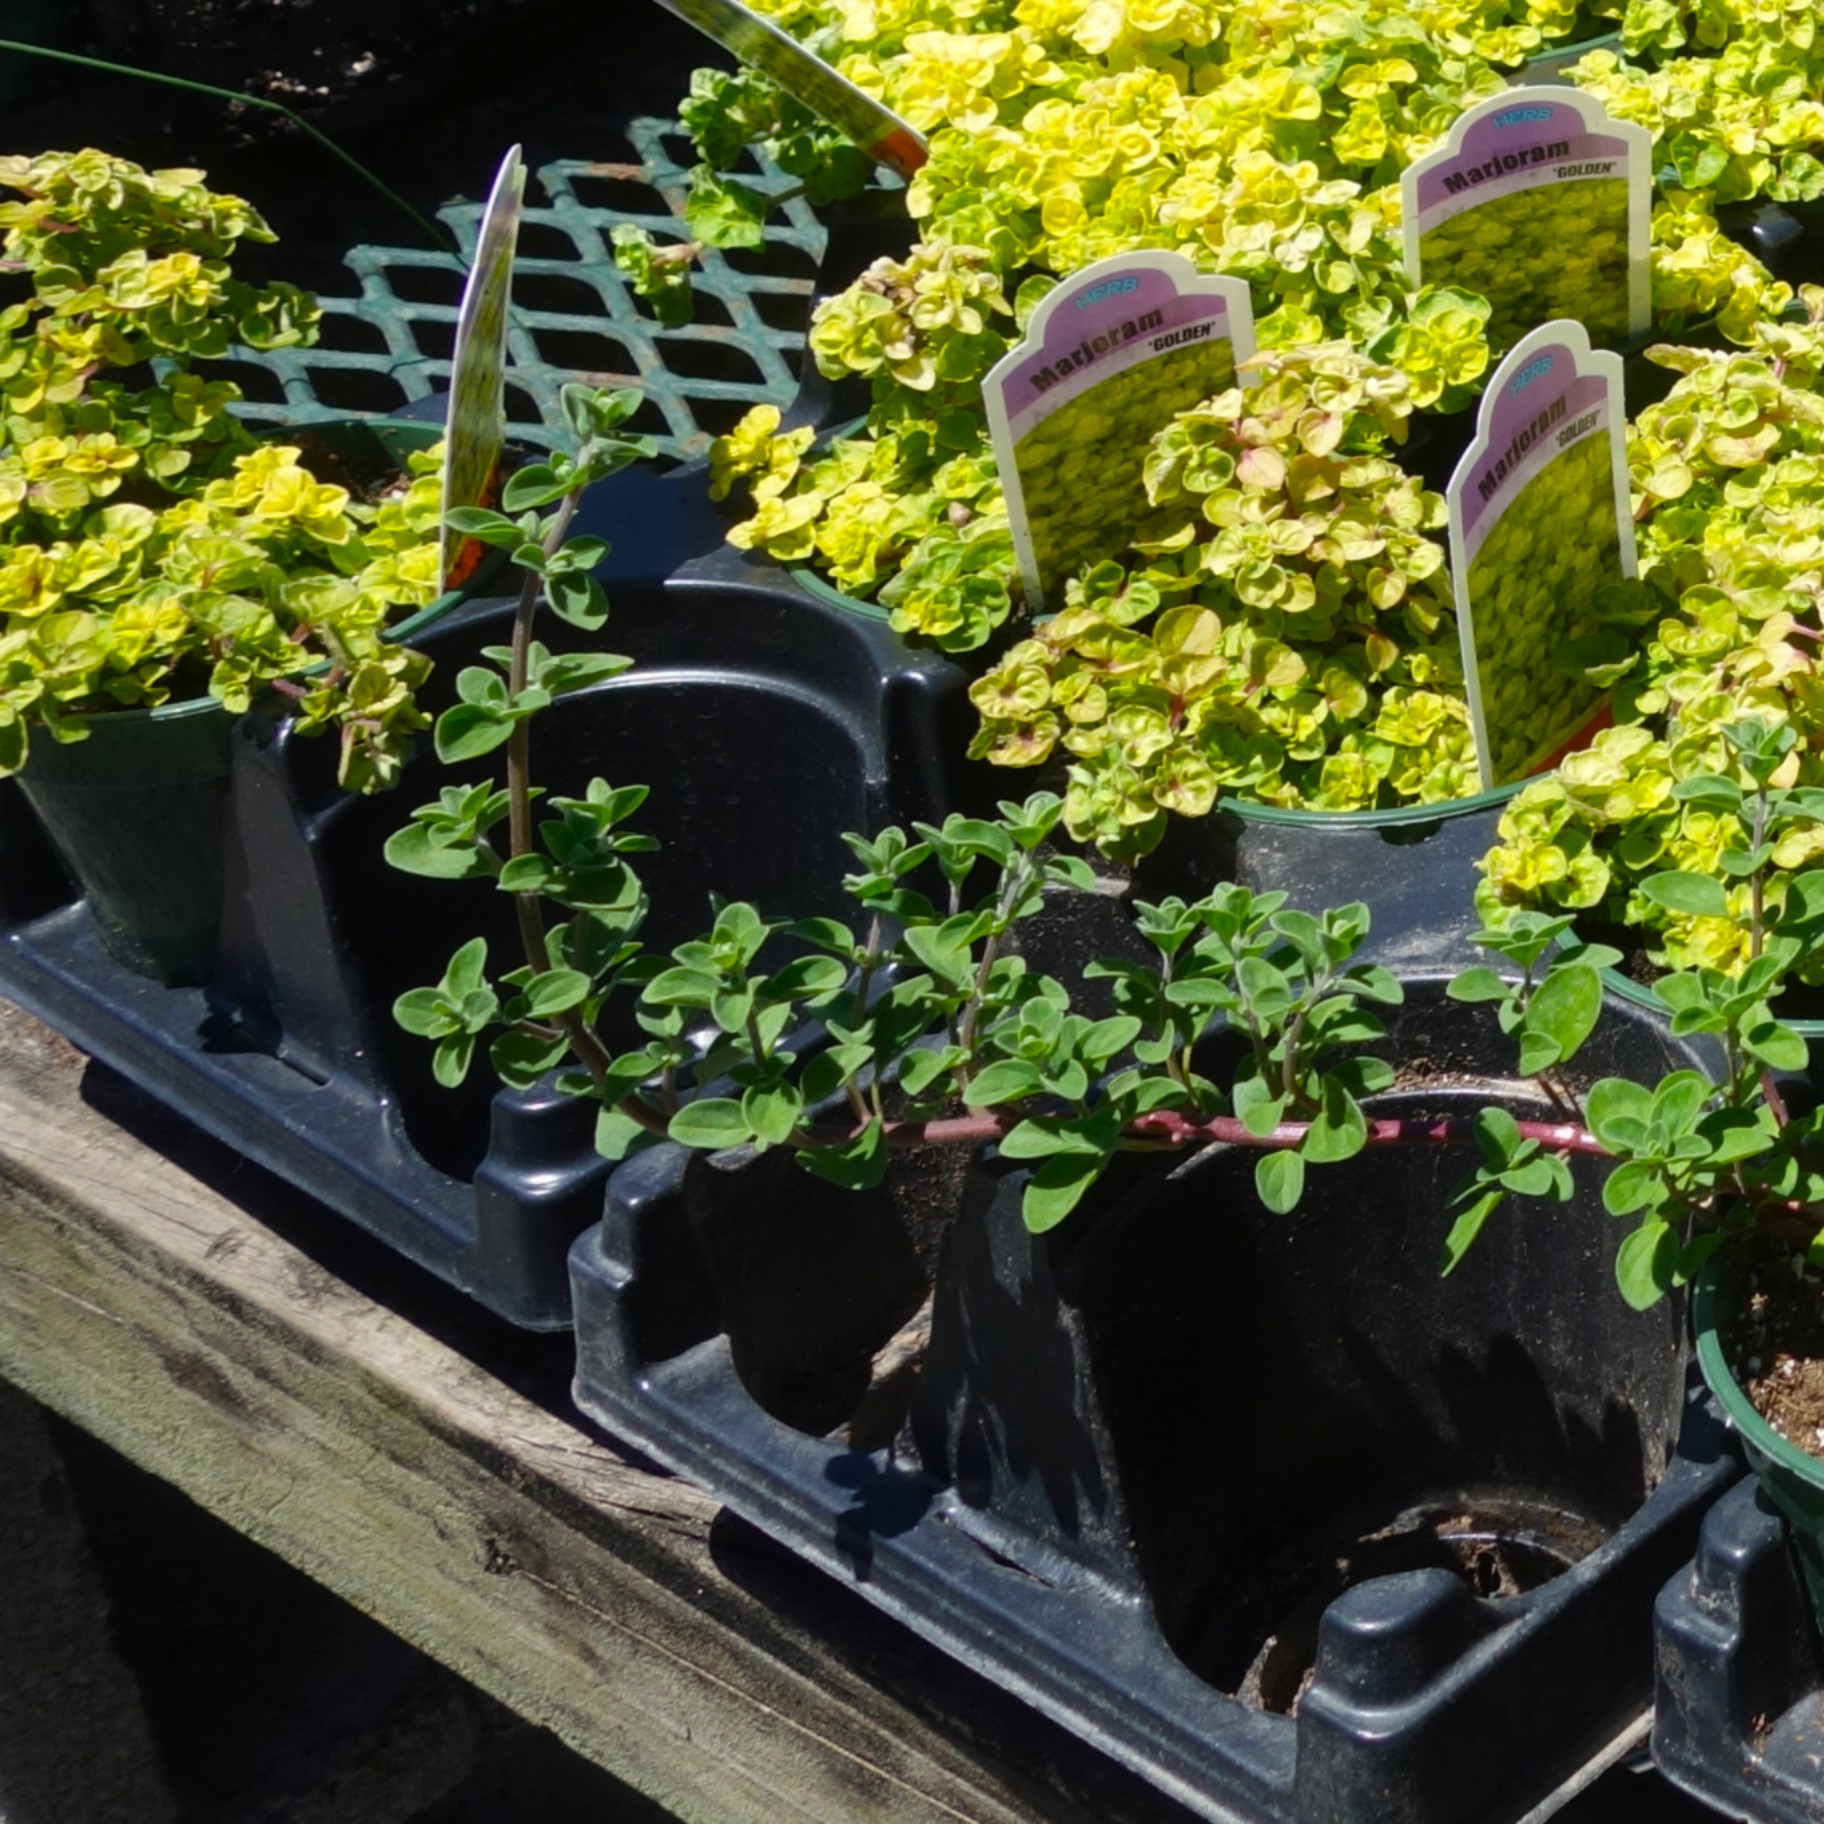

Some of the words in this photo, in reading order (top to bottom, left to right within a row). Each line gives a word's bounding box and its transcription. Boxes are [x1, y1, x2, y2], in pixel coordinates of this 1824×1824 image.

[1492, 107, 1554, 130] HERB
[1442, 139, 1570, 194] Marjoram
[1074, 277, 1139, 311] HERB
[1029, 307, 1164, 393] Marjoram
[1509, 354, 1553, 398] HERB
[1477, 394, 1567, 503] Marjoram
